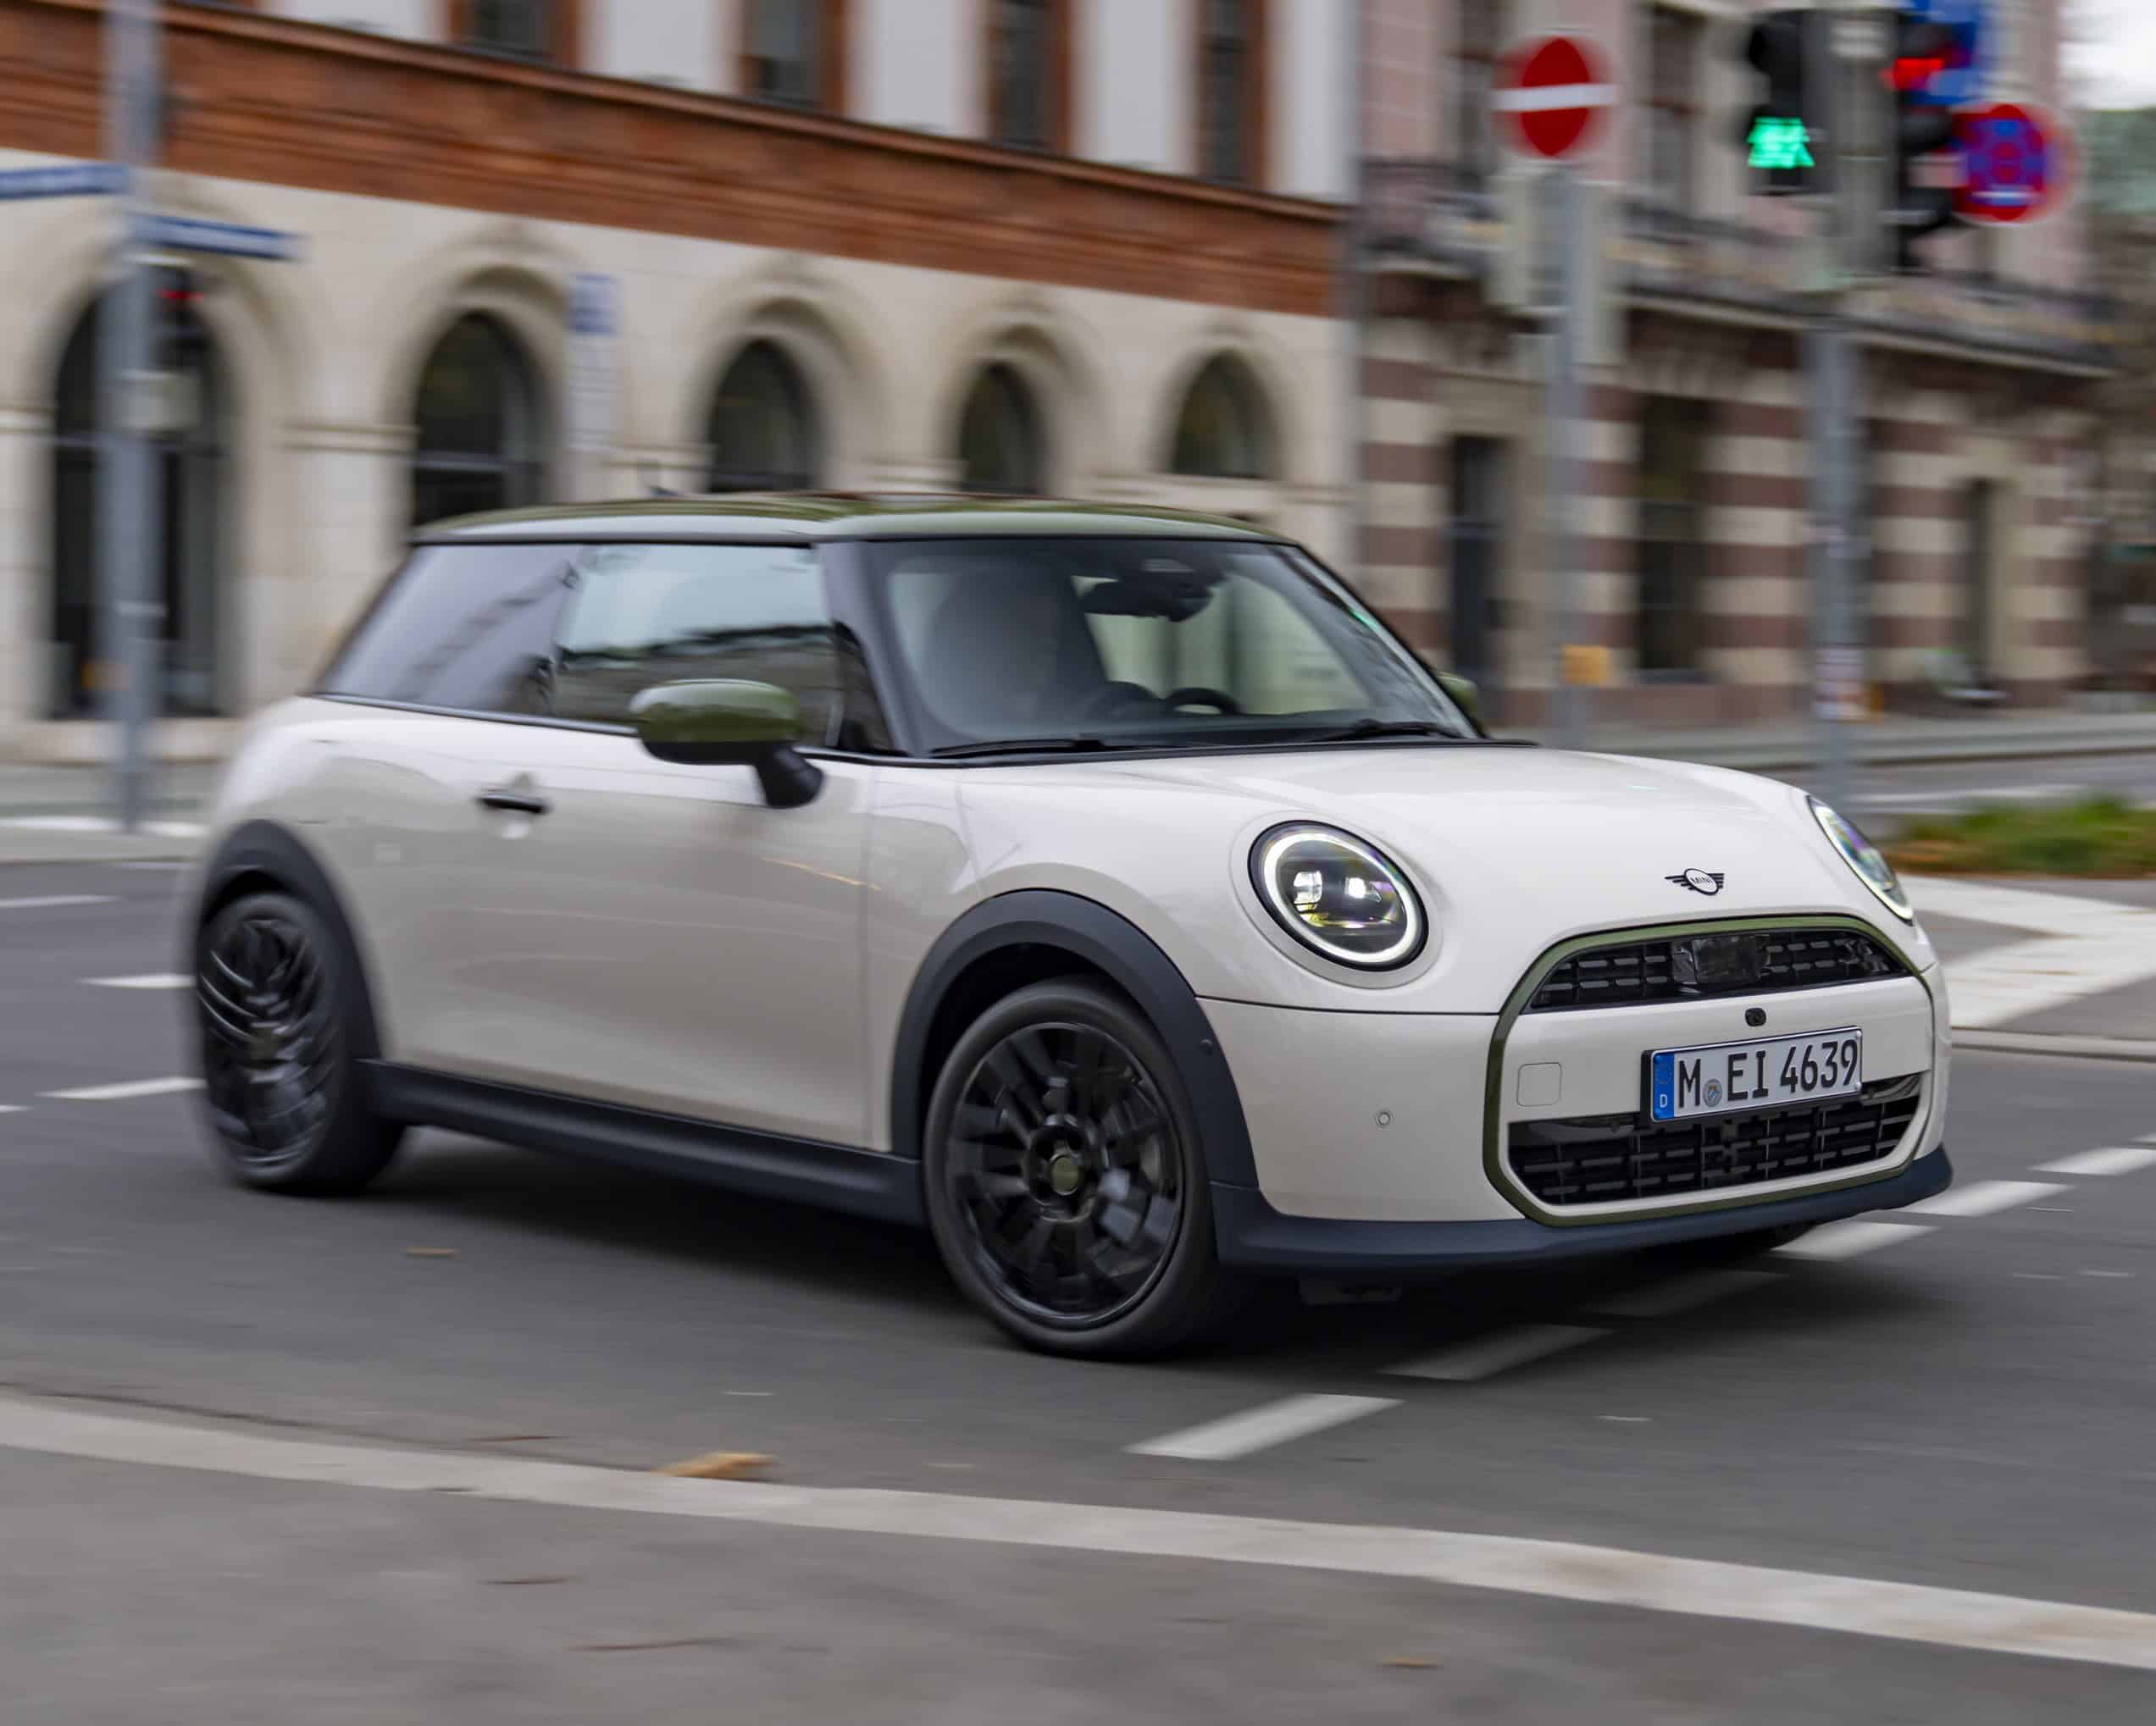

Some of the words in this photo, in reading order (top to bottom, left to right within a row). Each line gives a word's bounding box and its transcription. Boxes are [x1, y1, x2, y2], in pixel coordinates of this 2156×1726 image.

[1678, 1059, 1701, 1108] M
[1727, 1050, 1769, 1101] EI
[1780, 1039, 1858, 1093] 4639
[1660, 1093, 1668, 1108] D
